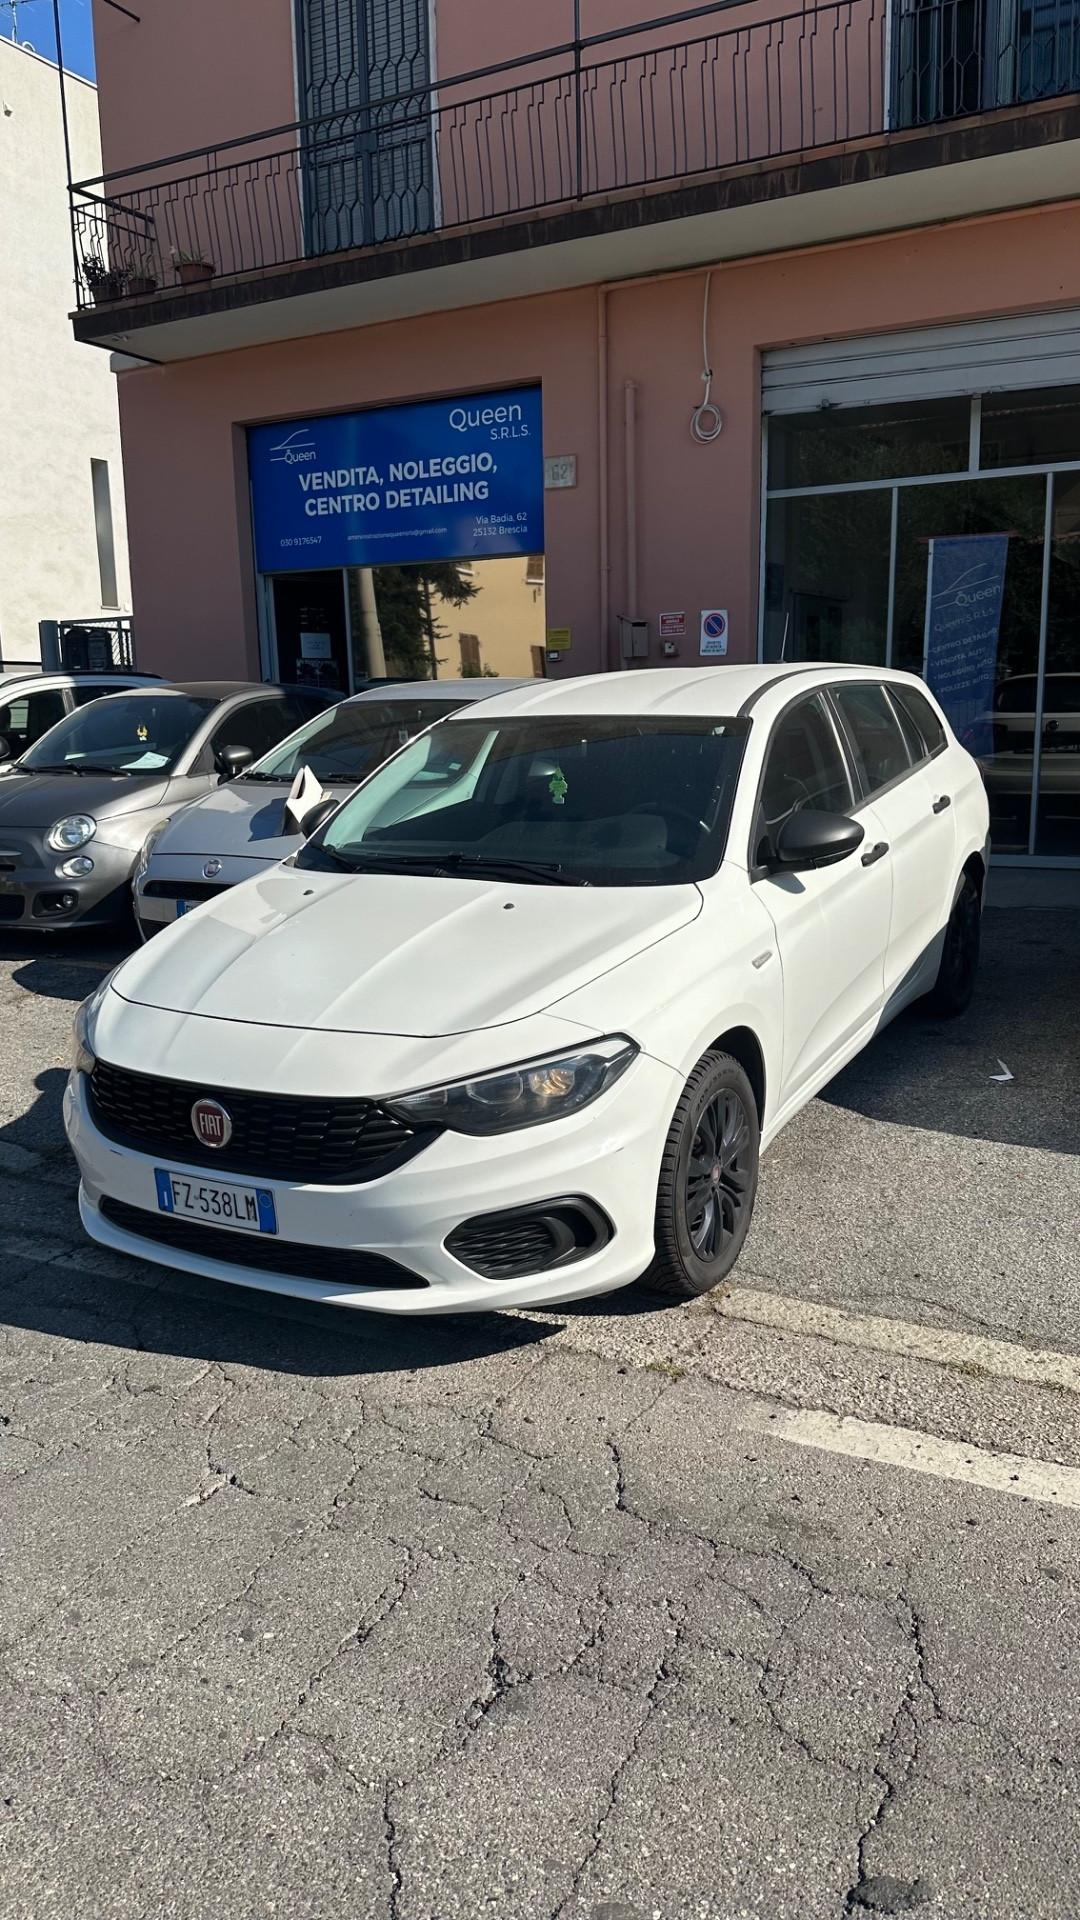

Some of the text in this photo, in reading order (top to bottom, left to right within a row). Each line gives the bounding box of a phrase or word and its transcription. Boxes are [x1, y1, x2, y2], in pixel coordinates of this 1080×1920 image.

[449, 404, 522, 432] Queen
[285, 450, 317, 464] Queen
[298, 452, 498, 492] VENDITA, NOLEGGIO,
[304, 480, 489, 517] CENTRO DETAILING
[475, 515, 489, 525] Via
[516, 511, 528, 521] 62
[472, 523, 528, 537] 25132 Brescia
[955, 585, 1001, 607] Queen
[199, 1112, 222, 1137] FIAT
